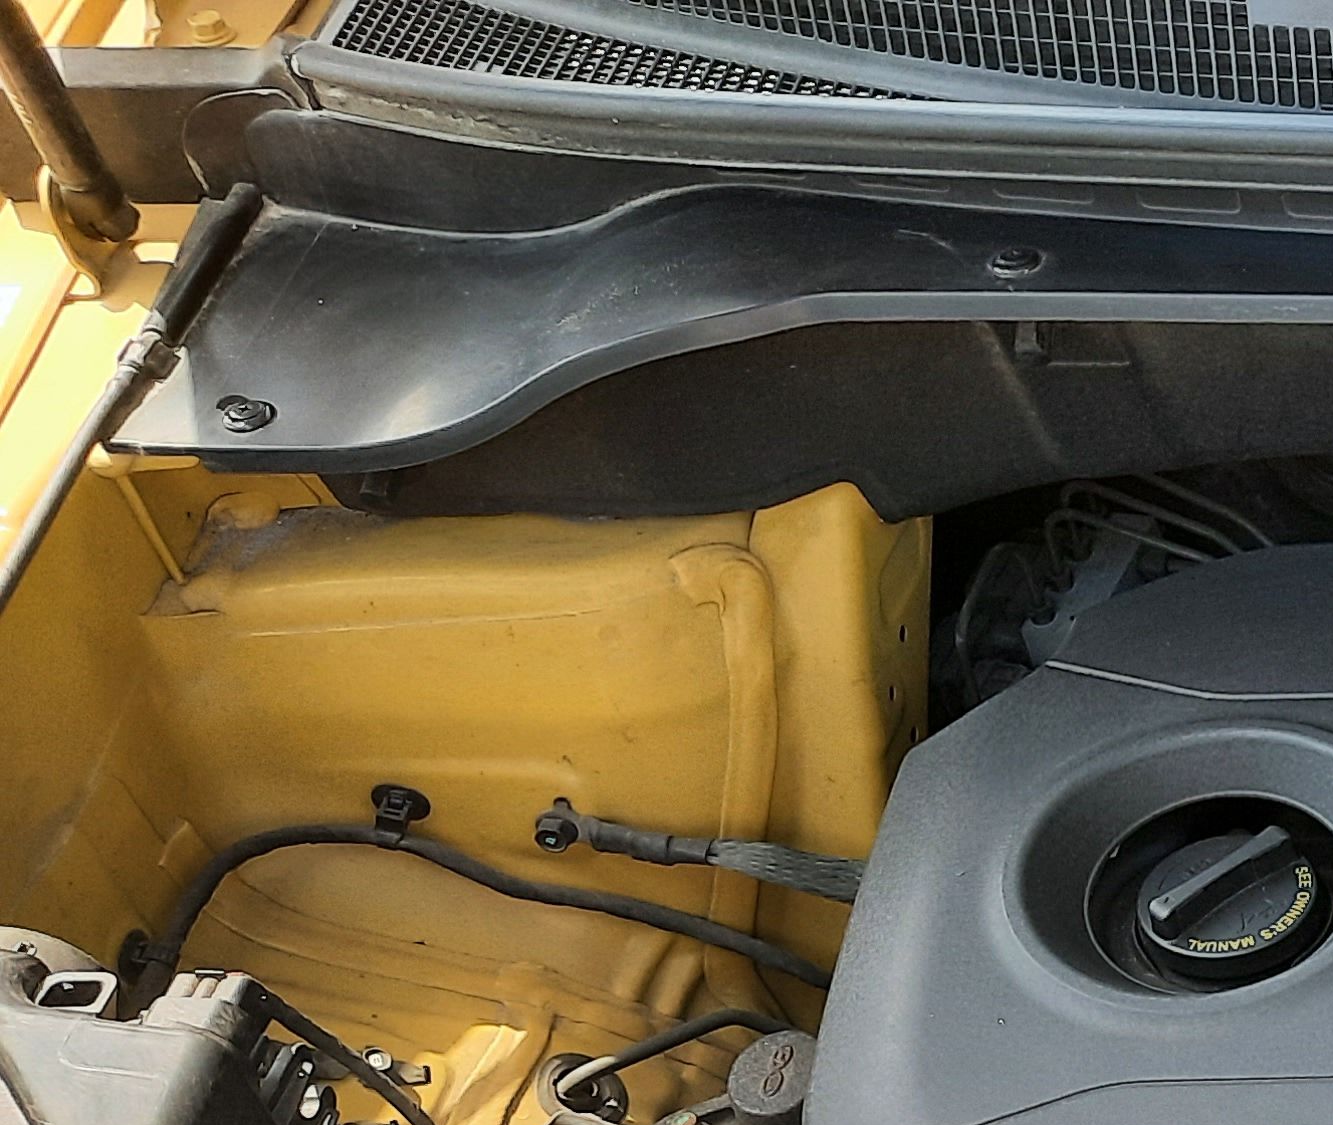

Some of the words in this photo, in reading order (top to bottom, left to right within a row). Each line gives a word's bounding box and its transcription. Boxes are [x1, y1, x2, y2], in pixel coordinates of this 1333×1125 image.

[1295, 866, 1312, 888] SEE
[1259, 891, 1311, 940] OWNER'S
[1188, 934, 1256, 952] MANUAL
